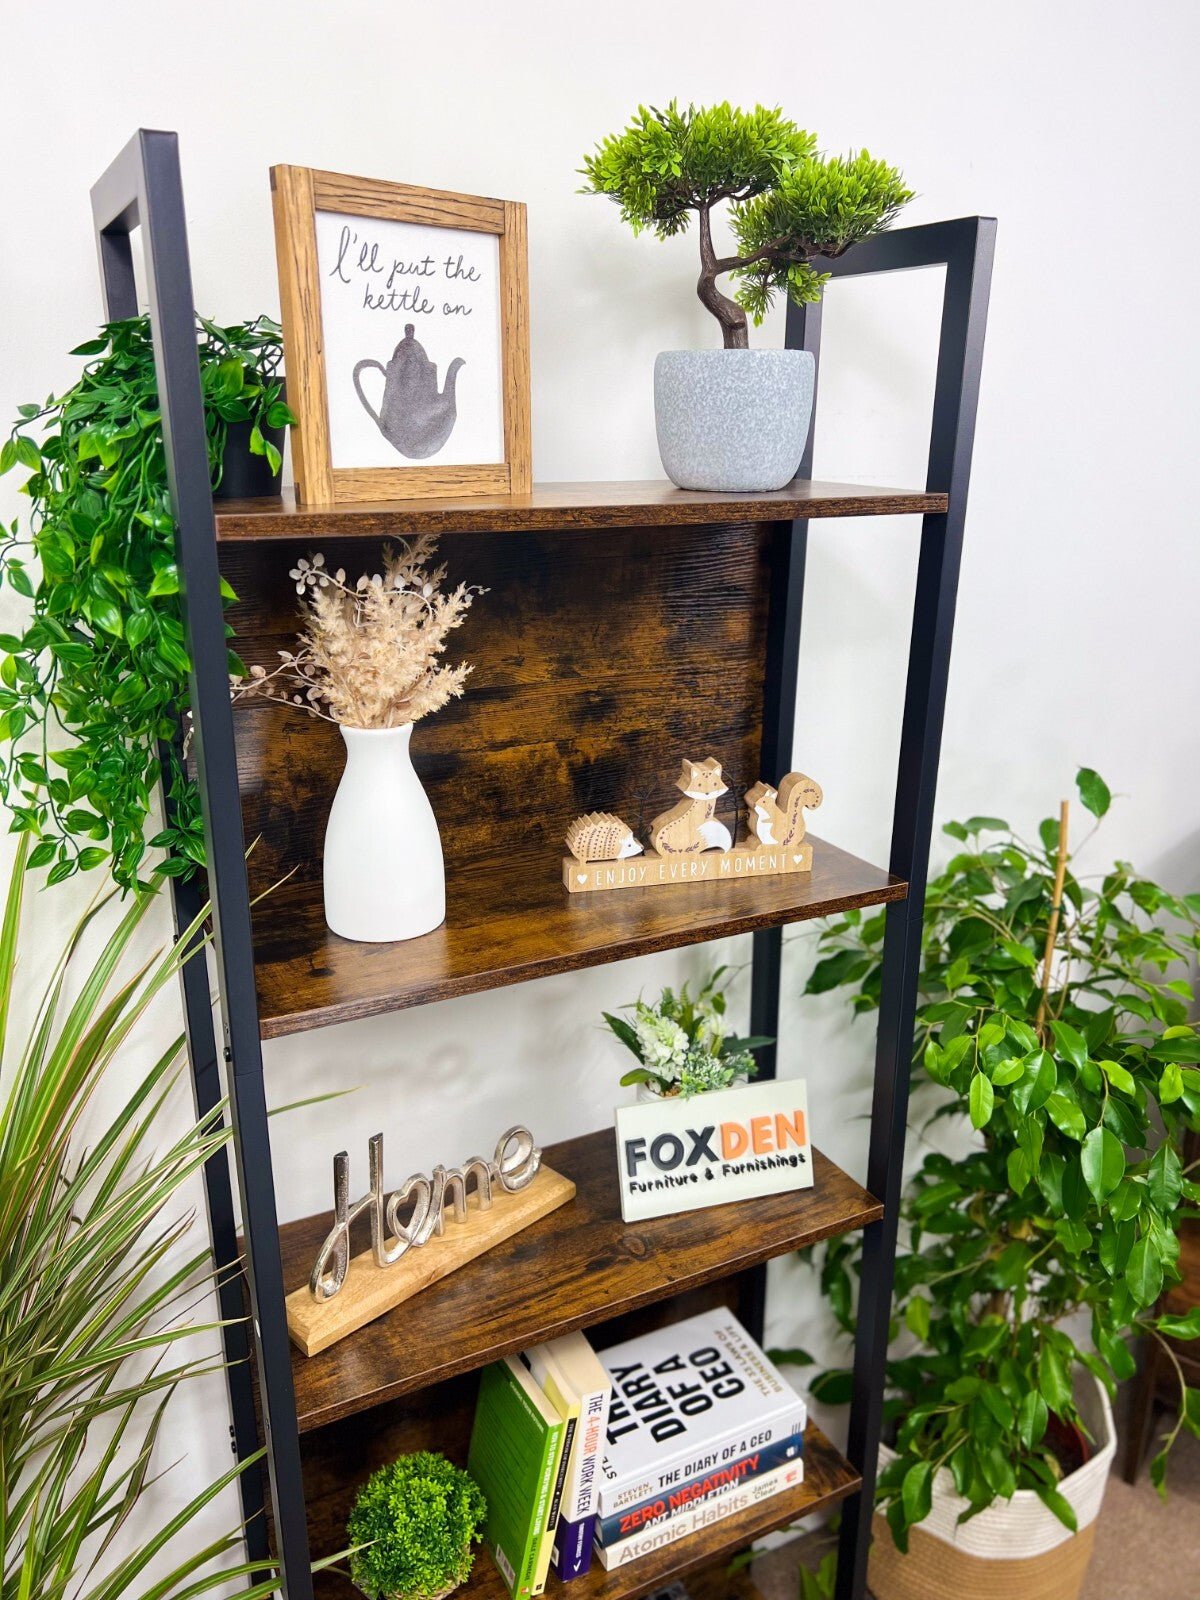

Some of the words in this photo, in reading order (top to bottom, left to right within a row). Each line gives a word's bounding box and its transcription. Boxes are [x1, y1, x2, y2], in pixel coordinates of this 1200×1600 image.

[386, 255, 436, 289] put
[443, 254, 481, 281] the
[363, 283, 434, 314] kettle
[442, 302, 472, 316] on
[596, 867, 647, 886] ENJOY
[659, 860, 708, 879] EVERY
[720, 853, 788, 873] MOMENT
[629, 1172, 698, 1195] Furniture
[704, 1167, 715, 1181] &
[722, 1153, 806, 1178] Furnishings
[309, 1125, 542, 1304] Home
[652, 1353, 687, 1376] A
[688, 1346, 745, 1399] CEO
[589, 1393, 603, 1414] THE
[609, 1362, 687, 1444] DIARY
[679, 1382, 713, 1417] OF
[583, 1415, 600, 1455] 4-HOUR
[580, 1454, 595, 1486] WORK
[658, 1469, 681, 1488] THE
[684, 1456, 719, 1477] DIARY
[722, 1446, 738, 1460] OF
[740, 1441, 747, 1453] A
[750, 1429, 772, 1448] CEO
[577, 1484, 592, 1516] WEEK
[613, 1487, 654, 1508] BARTLETT
[617, 1482, 650, 1500] STEVEN
[620, 1500, 666, 1533] ZERO
[669, 1454, 760, 1508] NEGATIVITY
[752, 1478, 778, 1494] James
[754, 1486, 776, 1500] Clear
[643, 1511, 669, 1531] ANT
[671, 1478, 739, 1517] MIDDLETON
[619, 1523, 688, 1562] Atomic
[692, 1494, 749, 1530] Habits
